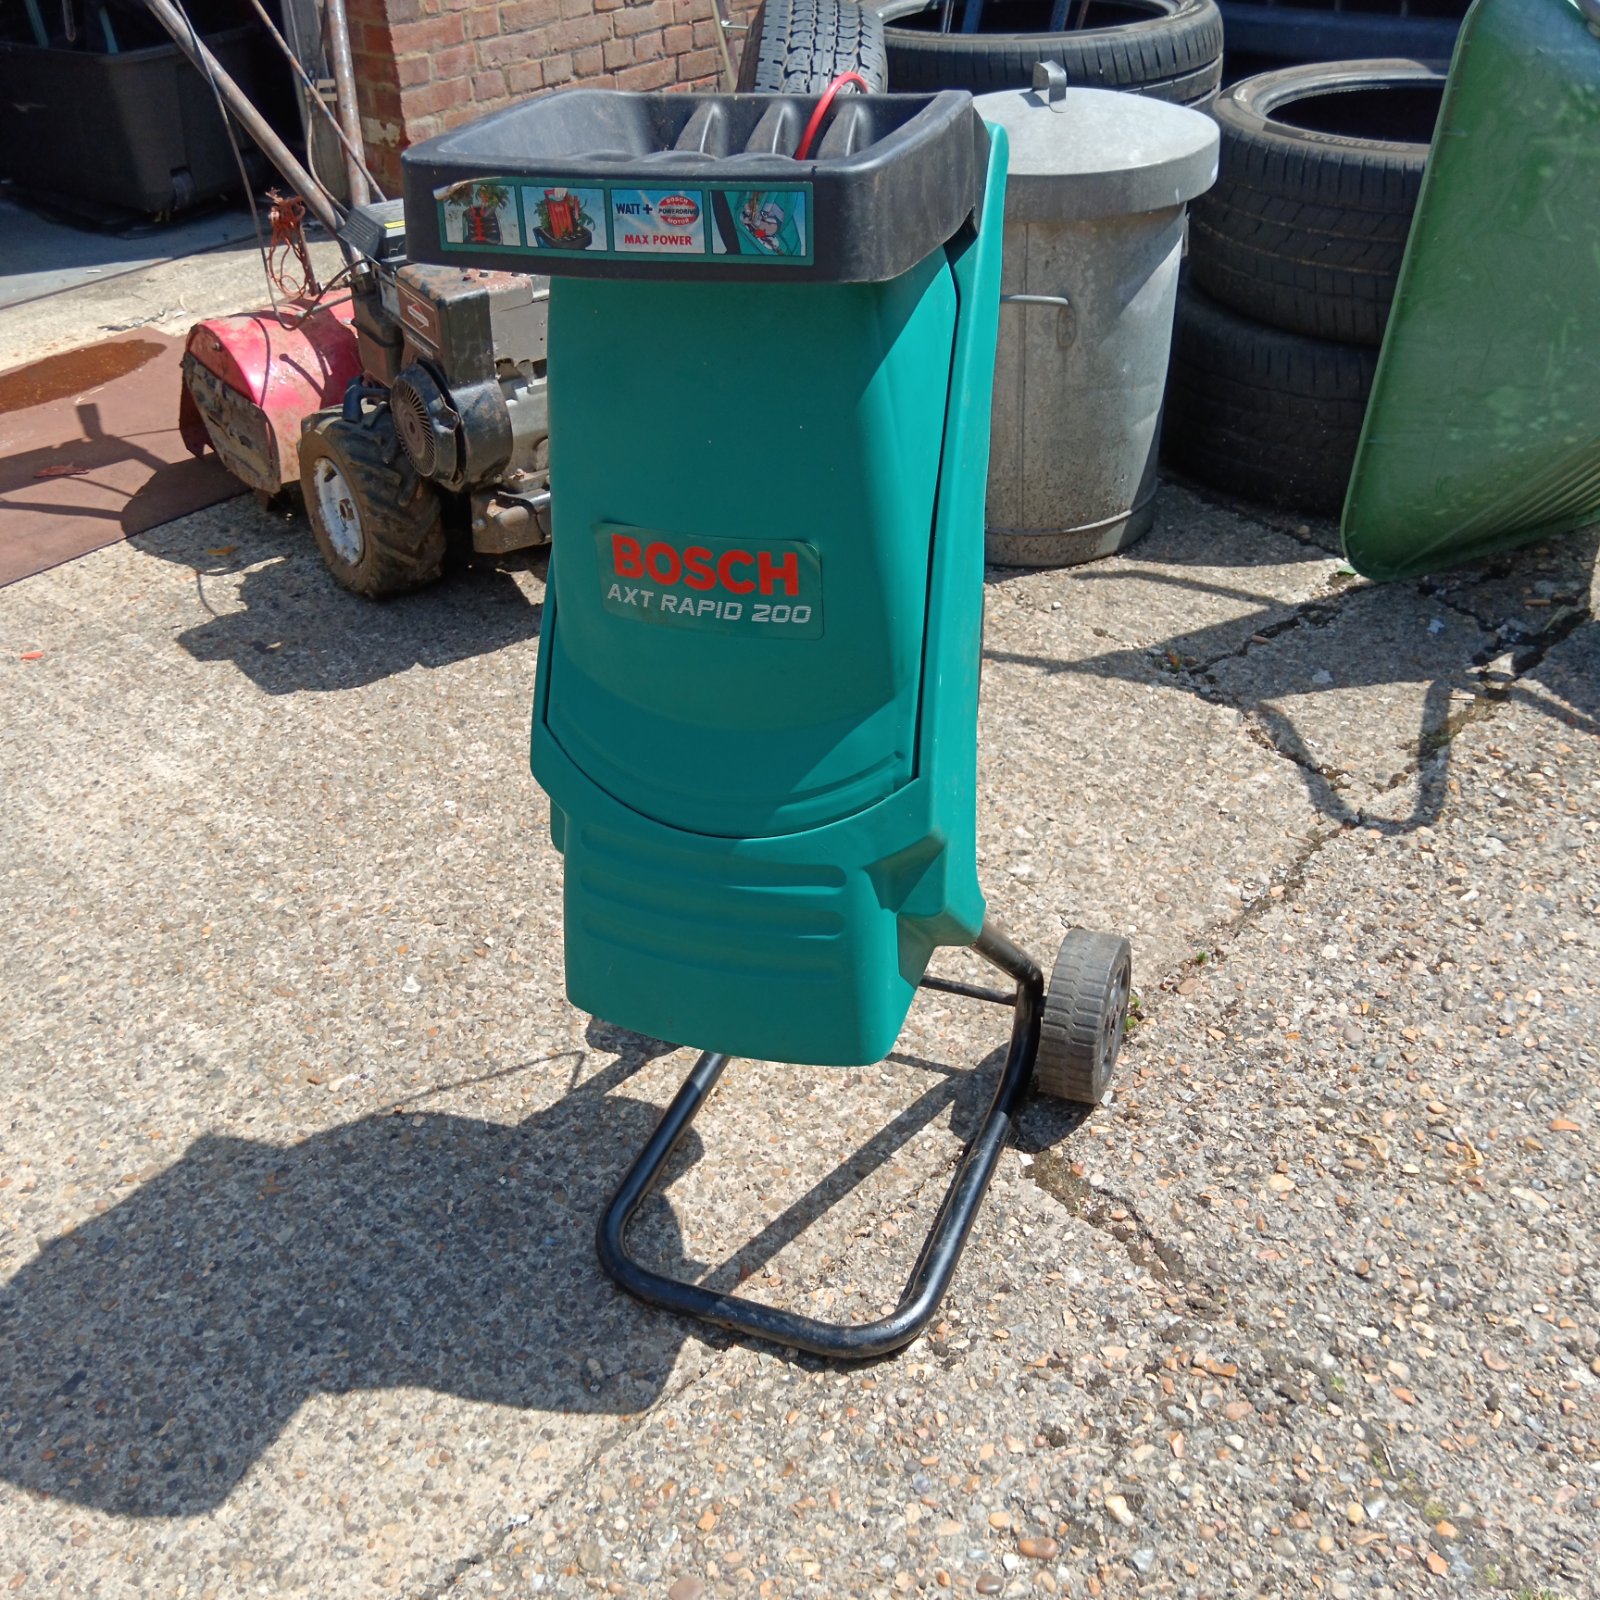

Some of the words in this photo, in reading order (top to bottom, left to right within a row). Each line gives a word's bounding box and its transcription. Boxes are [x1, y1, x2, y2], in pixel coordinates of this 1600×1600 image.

[615, 203, 640, 215] WATT
[624, 233, 649, 245] MAX
[652, 234, 692, 246] POWER
[611, 533, 799, 597] BOSCH
[607, 583, 654, 609] AXT
[659, 594, 743, 621] RAPID
[751, 603, 812, 624] 200
